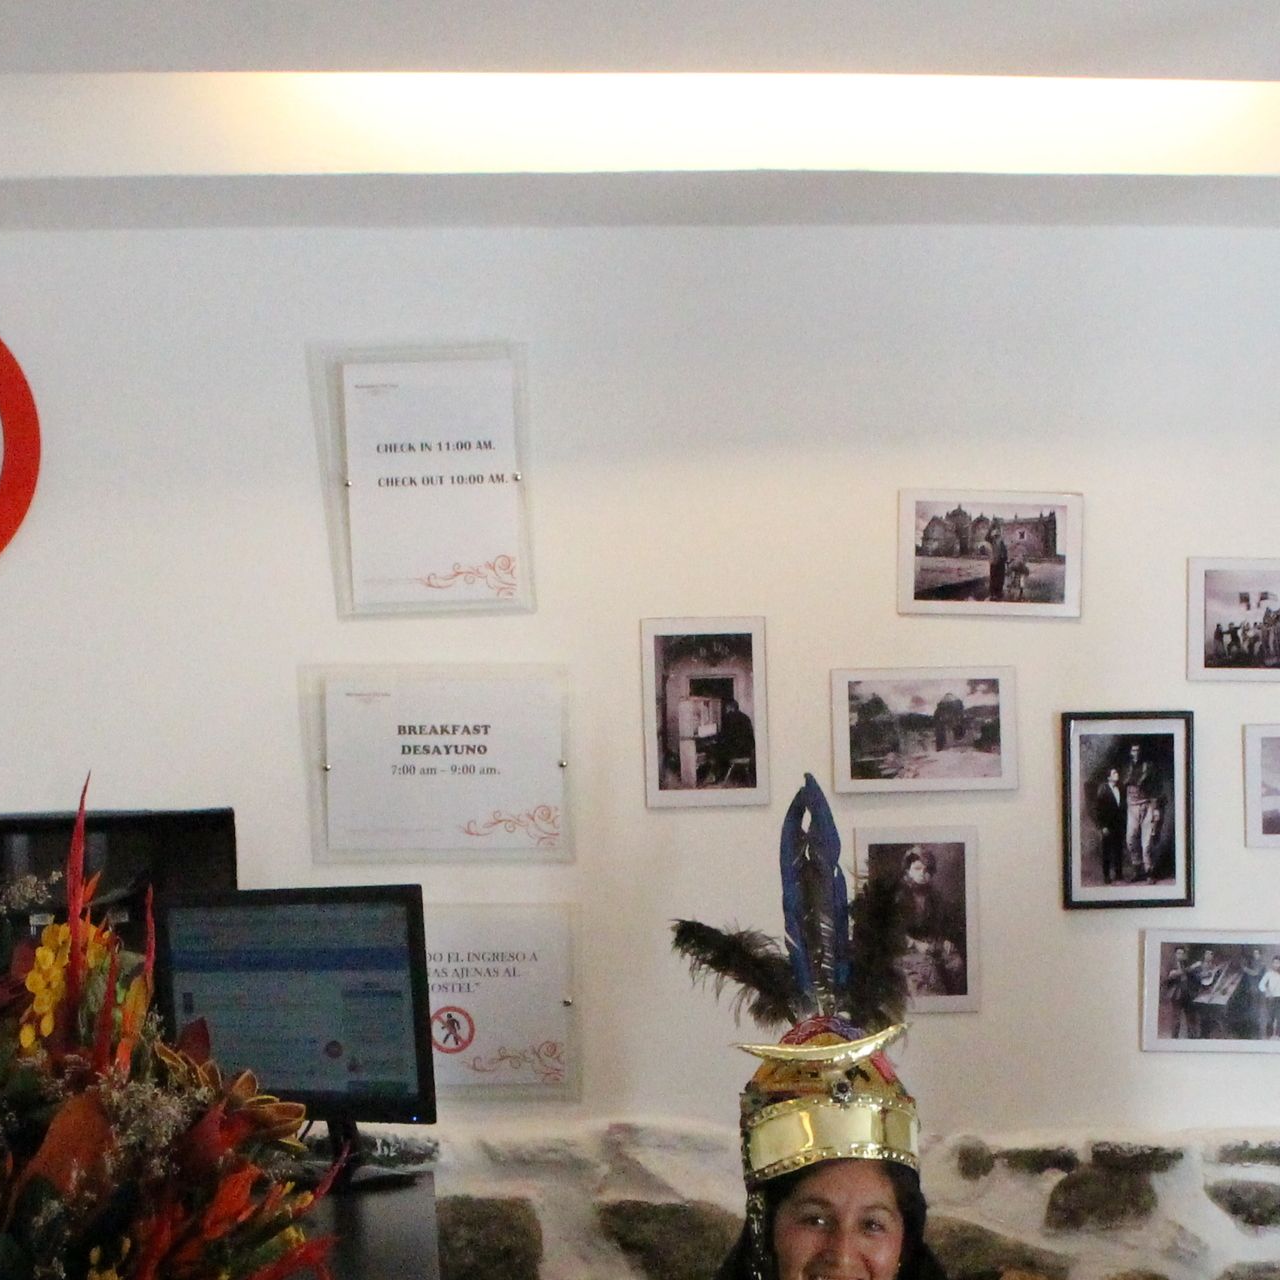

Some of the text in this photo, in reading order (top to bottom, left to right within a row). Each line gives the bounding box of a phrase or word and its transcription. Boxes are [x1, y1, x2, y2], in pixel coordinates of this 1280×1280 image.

[376, 439, 496, 453] CHECK IN 11:00 AM.
[377, 476, 417, 487] CHECK
[421, 475, 444, 486] OUT
[450, 474, 484, 485] 10:00
[397, 724, 491, 735] BREAKFAST
[401, 744, 488, 755] DESAYUNO
[391, 764, 416, 775] 7:00
[419, 767, 437, 775] am
[450, 764, 476, 775] 9:00
[479, 766, 501, 775] am.
[467, 952, 526, 962] INGRESO
[529, 952, 538, 961] A
[503, 967, 521, 977] AL
